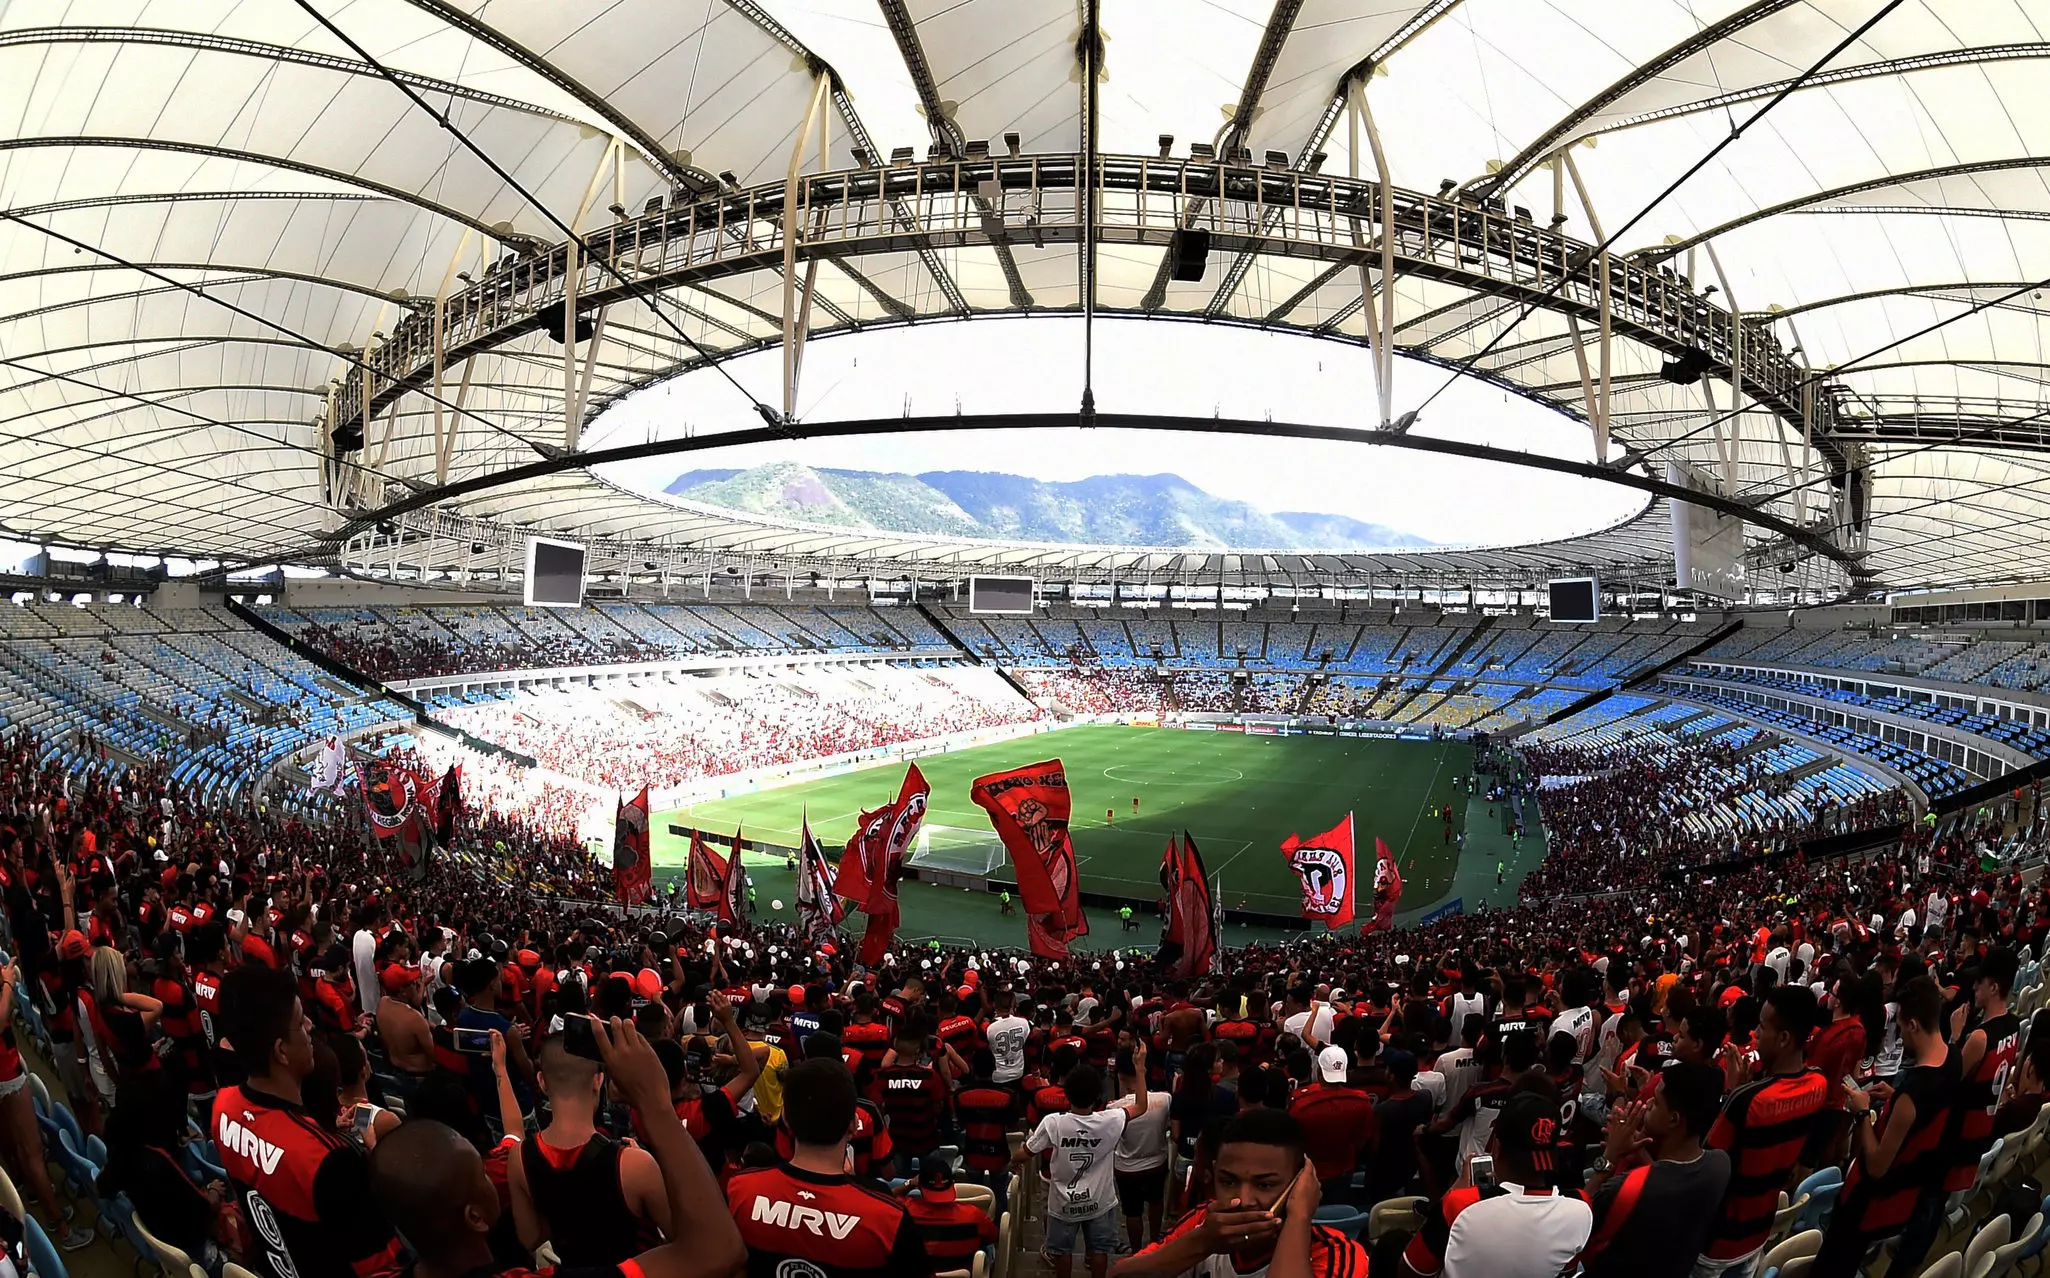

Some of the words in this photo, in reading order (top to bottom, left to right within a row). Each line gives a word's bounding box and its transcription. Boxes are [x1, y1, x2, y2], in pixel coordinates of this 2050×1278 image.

[794, 1017, 820, 1030] MRV
[941, 1019, 970, 1033] PEUGEOT
[1500, 1022, 1526, 1032] MRV
[1572, 1011, 1591, 1030] MRV
[995, 1027, 1025, 1057] 35
[888, 1079, 922, 1090] MRV
[219, 1112, 285, 1176] MRV
[1061, 1137, 1102, 1148] MRV
[1067, 1152, 1094, 1189] 7
[1070, 1202, 1099, 1215] RIBEIRO
[751, 1195, 861, 1240] MRV
